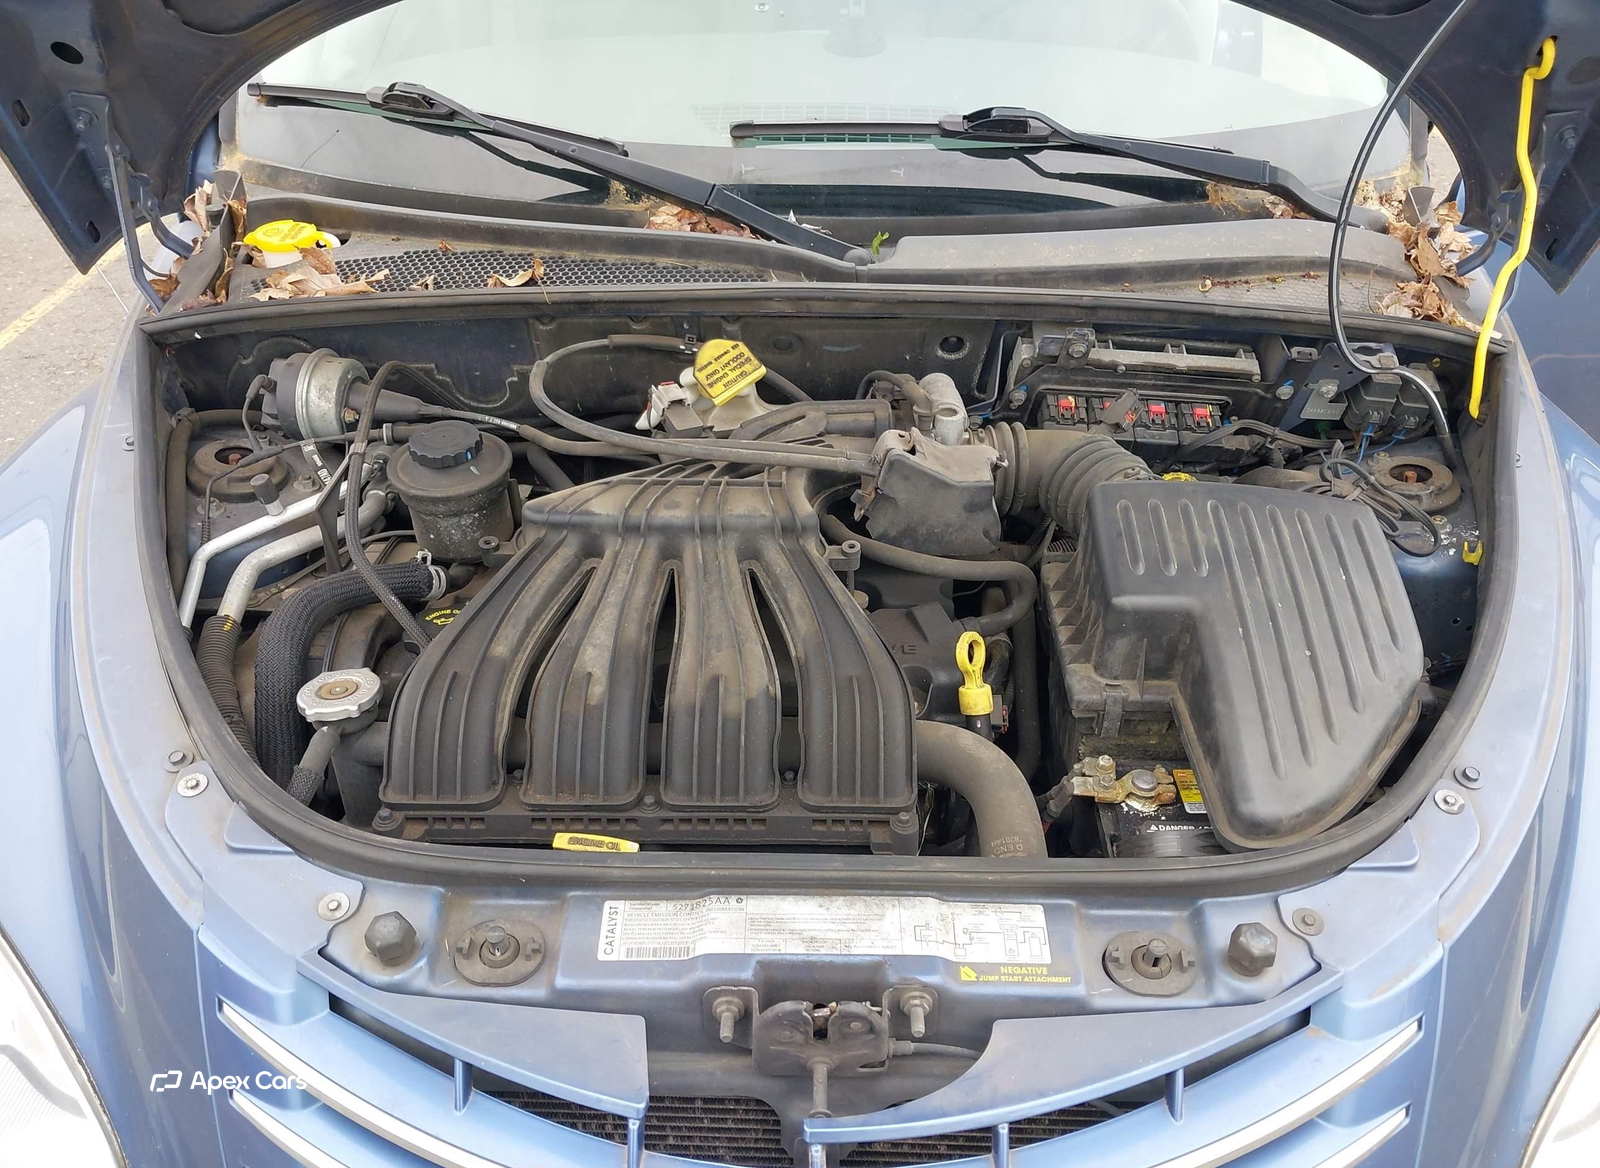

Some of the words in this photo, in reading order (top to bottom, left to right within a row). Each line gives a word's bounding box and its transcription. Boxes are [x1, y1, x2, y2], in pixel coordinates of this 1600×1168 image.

[720, 351, 745, 370] COOLANT
[729, 356, 752, 373] SPECIAL
[705, 369, 720, 382] ONLY
[706, 371, 729, 389] ENGINE
[723, 370, 748, 388] CAUTION
[425, 609, 452, 620] ENGINE
[568, 836, 606, 848] ENGINE
[606, 842, 621, 851] OIL
[673, 896, 731, 911] 5273825AA
[604, 905, 619, 956] CATALYST
[1000, 966, 1048, 975] NEGATIVE
[1001, 975, 1022, 983] START
[1023, 975, 1072, 983] ATTACHMENT
